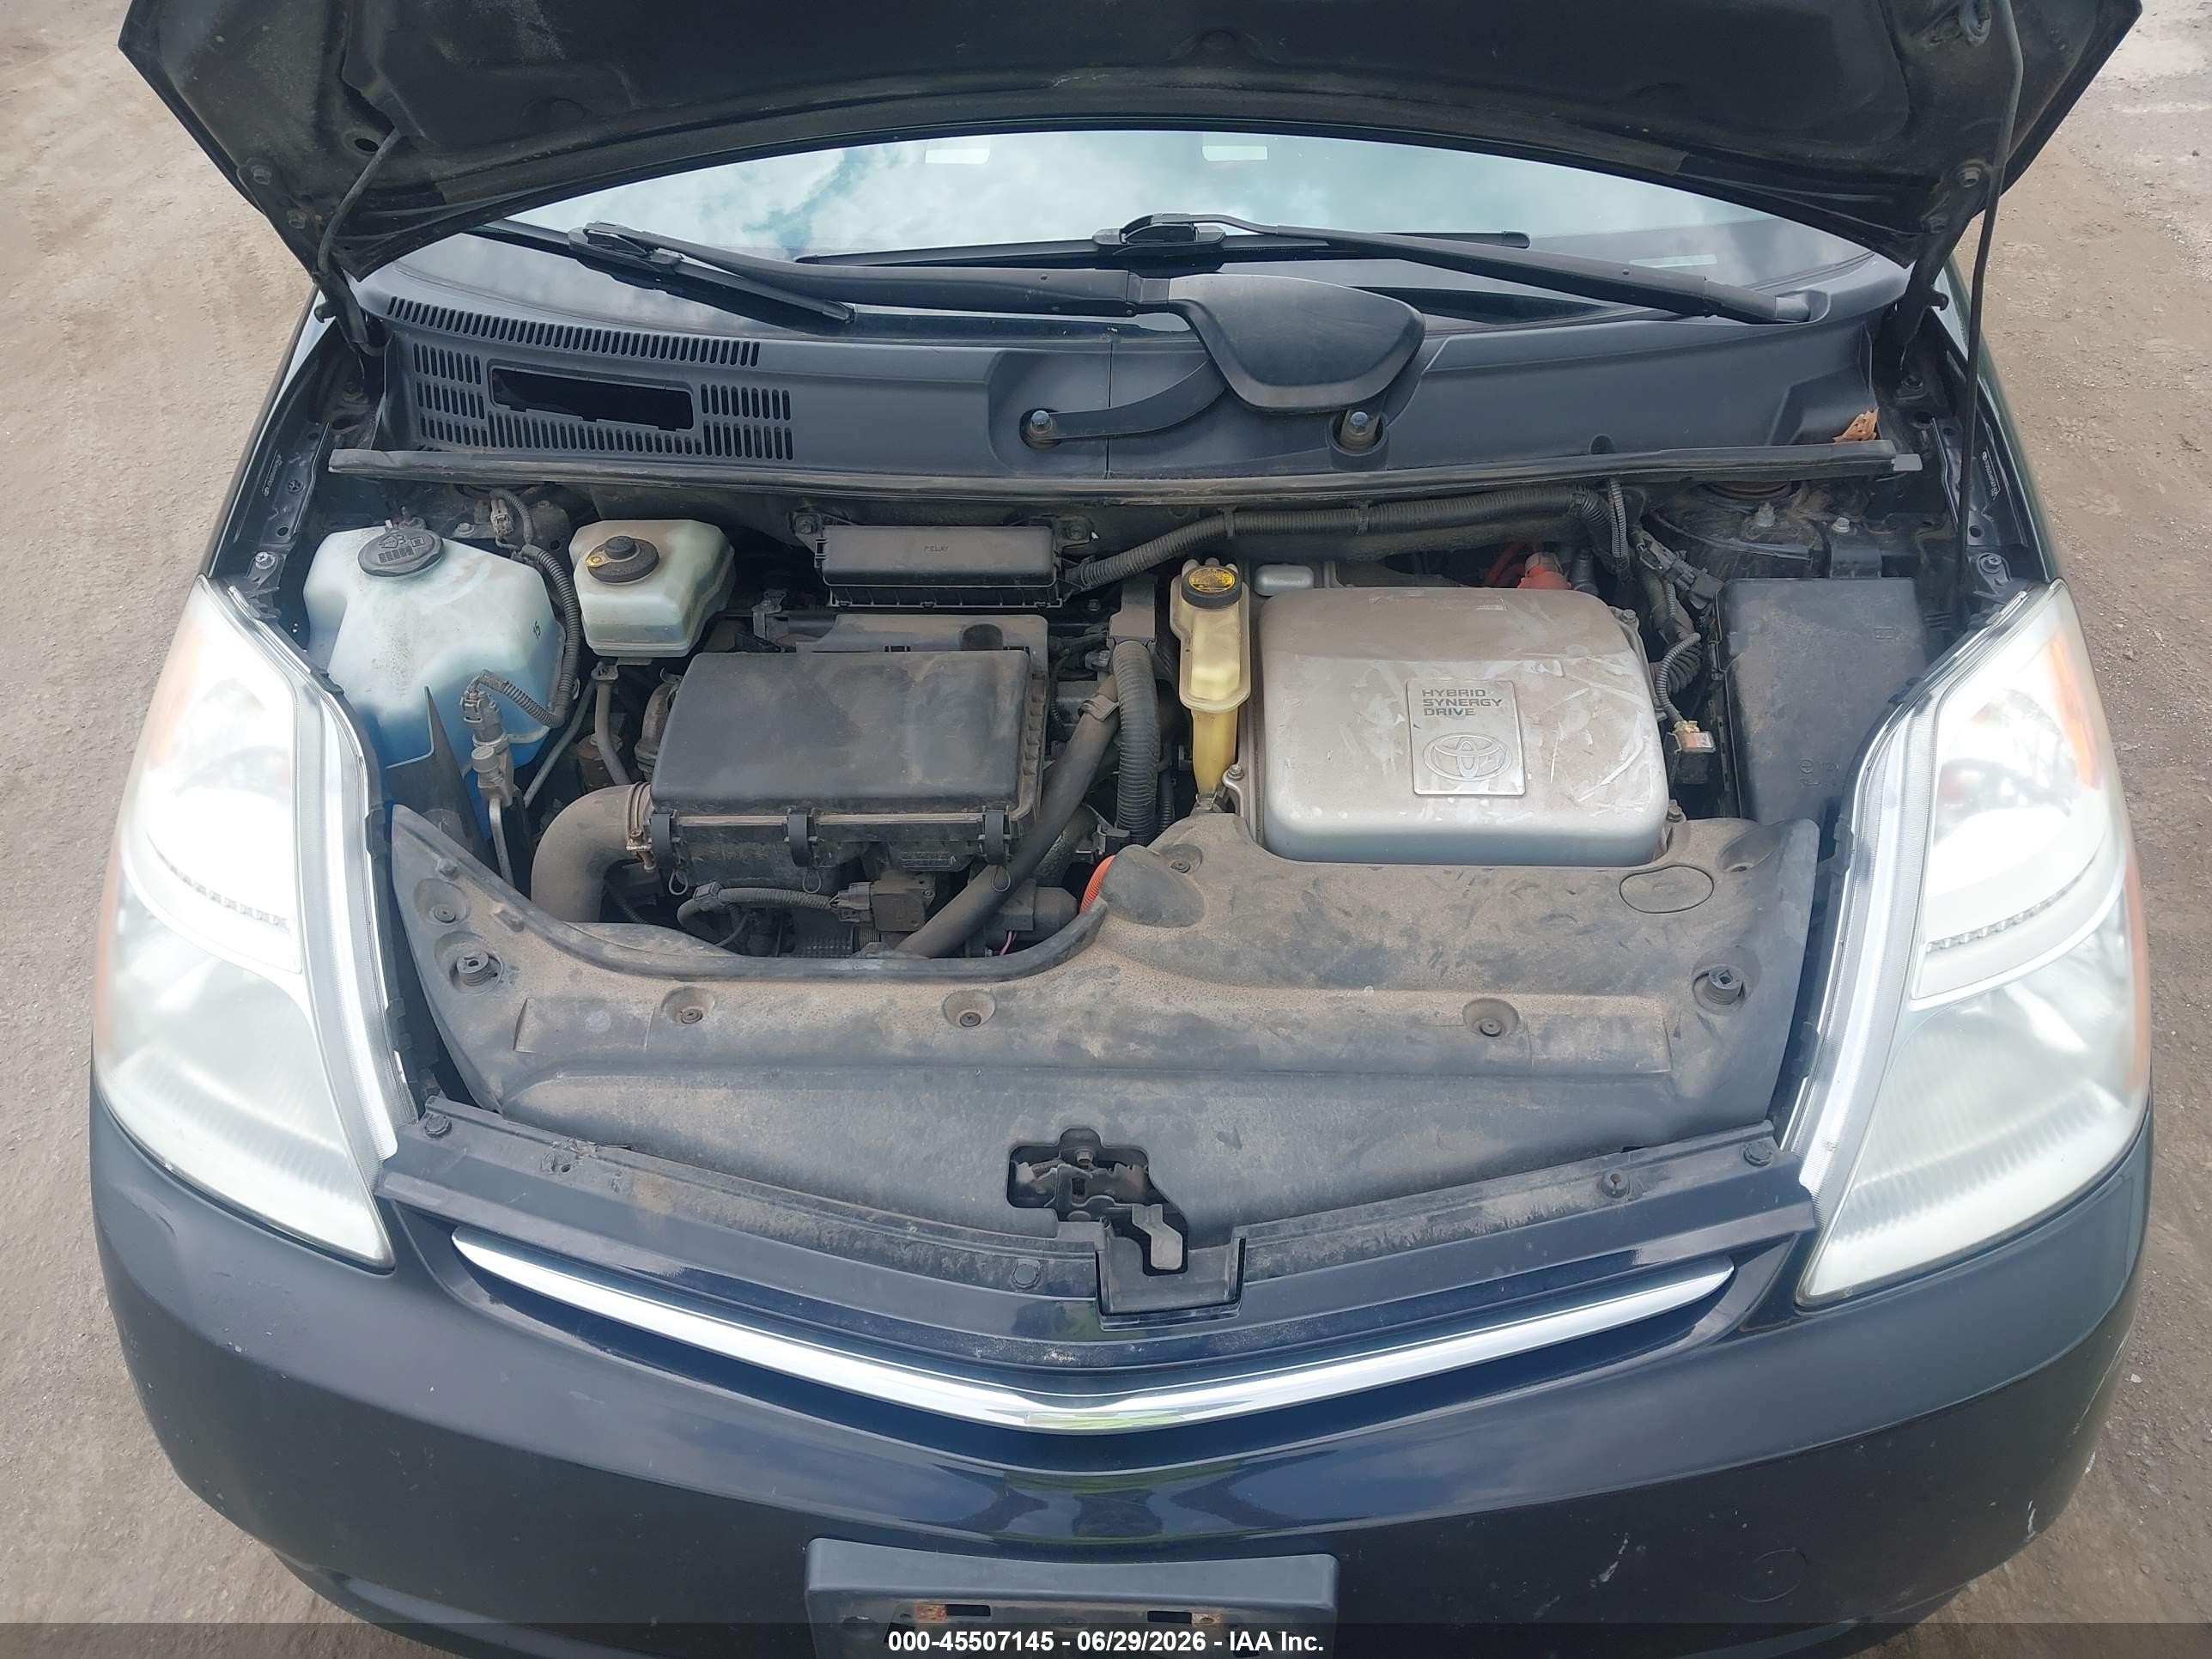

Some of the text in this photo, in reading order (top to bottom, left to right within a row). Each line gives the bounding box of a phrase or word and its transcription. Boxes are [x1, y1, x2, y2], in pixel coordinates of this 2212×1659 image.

[1421, 689, 1486, 697] HYBRID
[1421, 698, 1503, 707] SYNERGY
[1423, 708, 1477, 716] DRIVE
